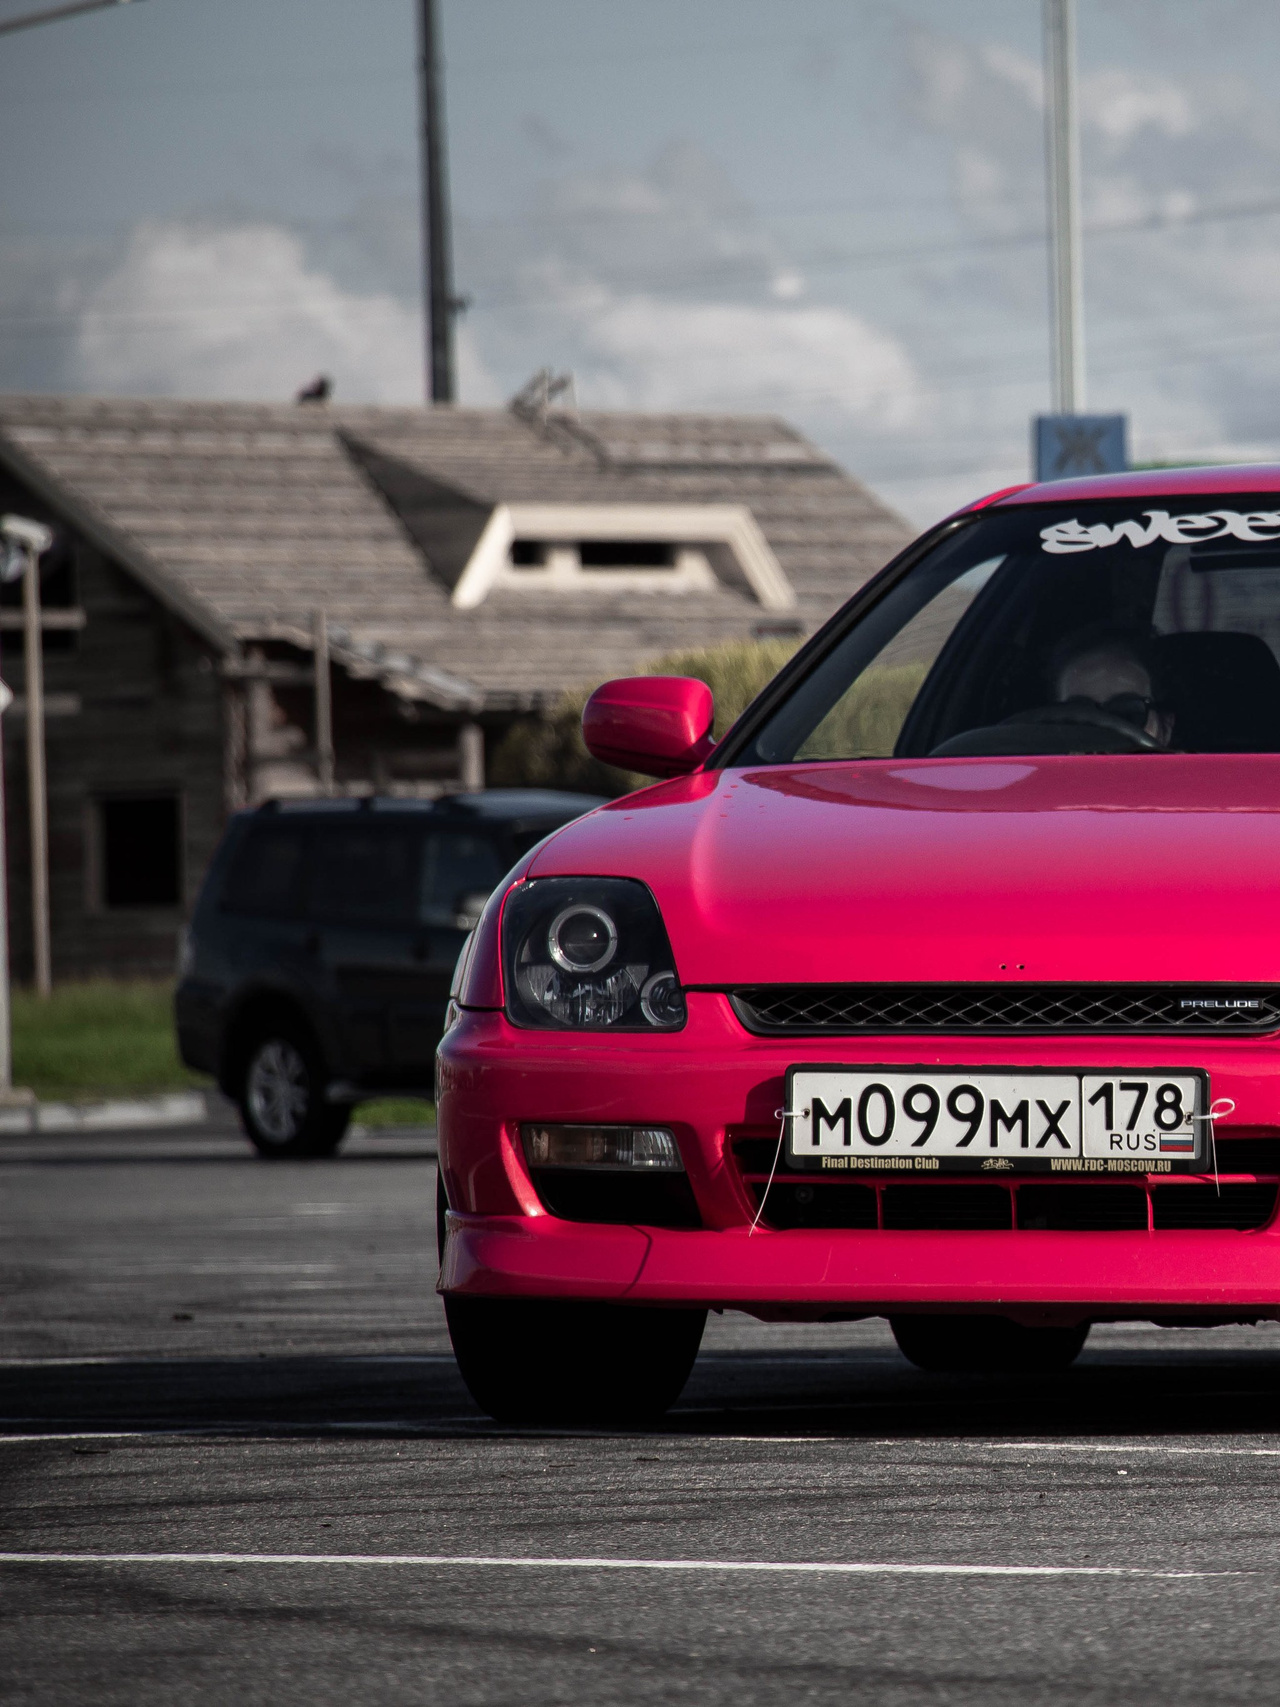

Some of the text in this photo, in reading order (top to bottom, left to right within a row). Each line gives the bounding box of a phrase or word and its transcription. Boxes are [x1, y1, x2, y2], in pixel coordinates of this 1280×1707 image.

[1180, 1000, 1260, 1008] PRELUDE
[1088, 1082, 1184, 1131] 178
[1109, 1133, 1157, 1151] RUS
[821, 1156, 940, 1170] Final Destination Club
[1050, 1158, 1172, 1172] WWW.FDC-MOSCOW.RU
